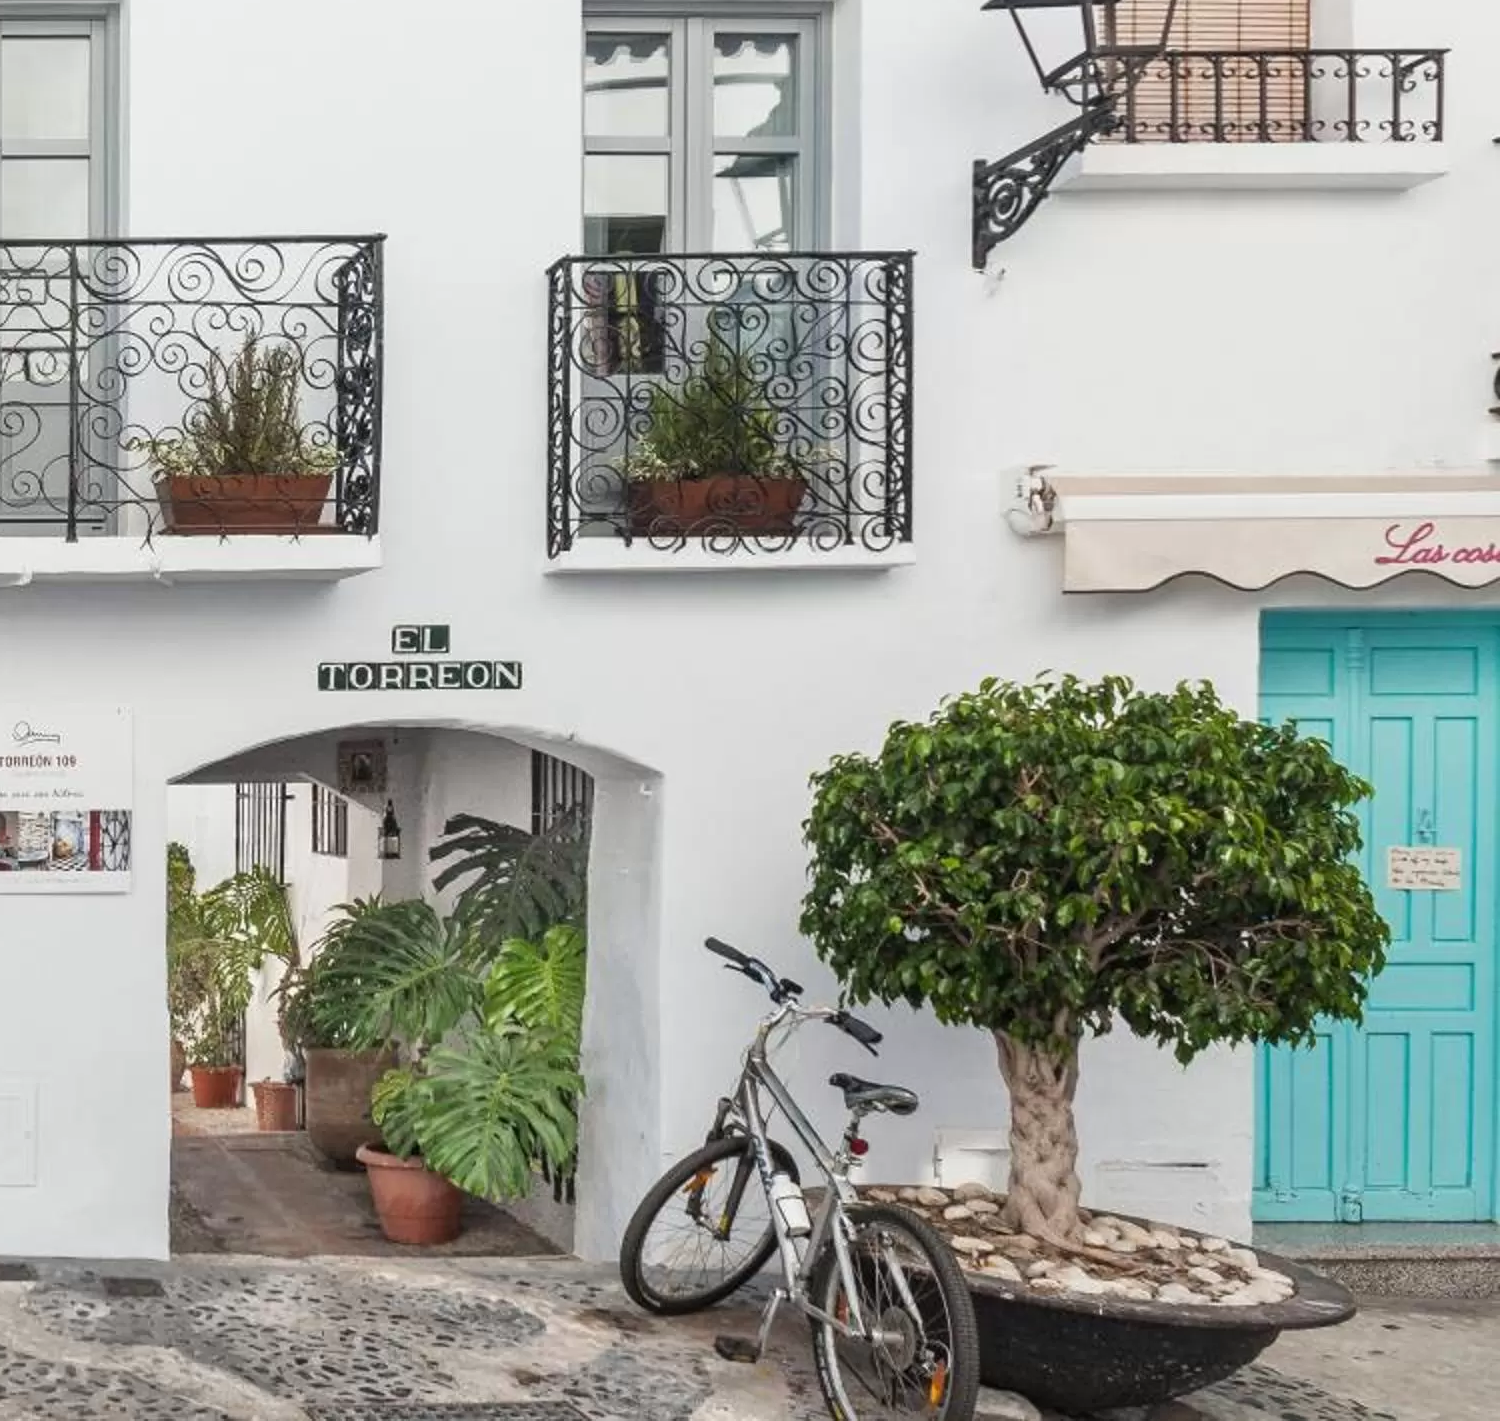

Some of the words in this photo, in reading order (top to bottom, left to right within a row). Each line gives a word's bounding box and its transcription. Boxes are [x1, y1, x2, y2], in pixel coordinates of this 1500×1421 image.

[1374, 522, 1451, 564] Las
[392, 627, 448, 652] EL
[320, 662, 521, 689] TORREON
